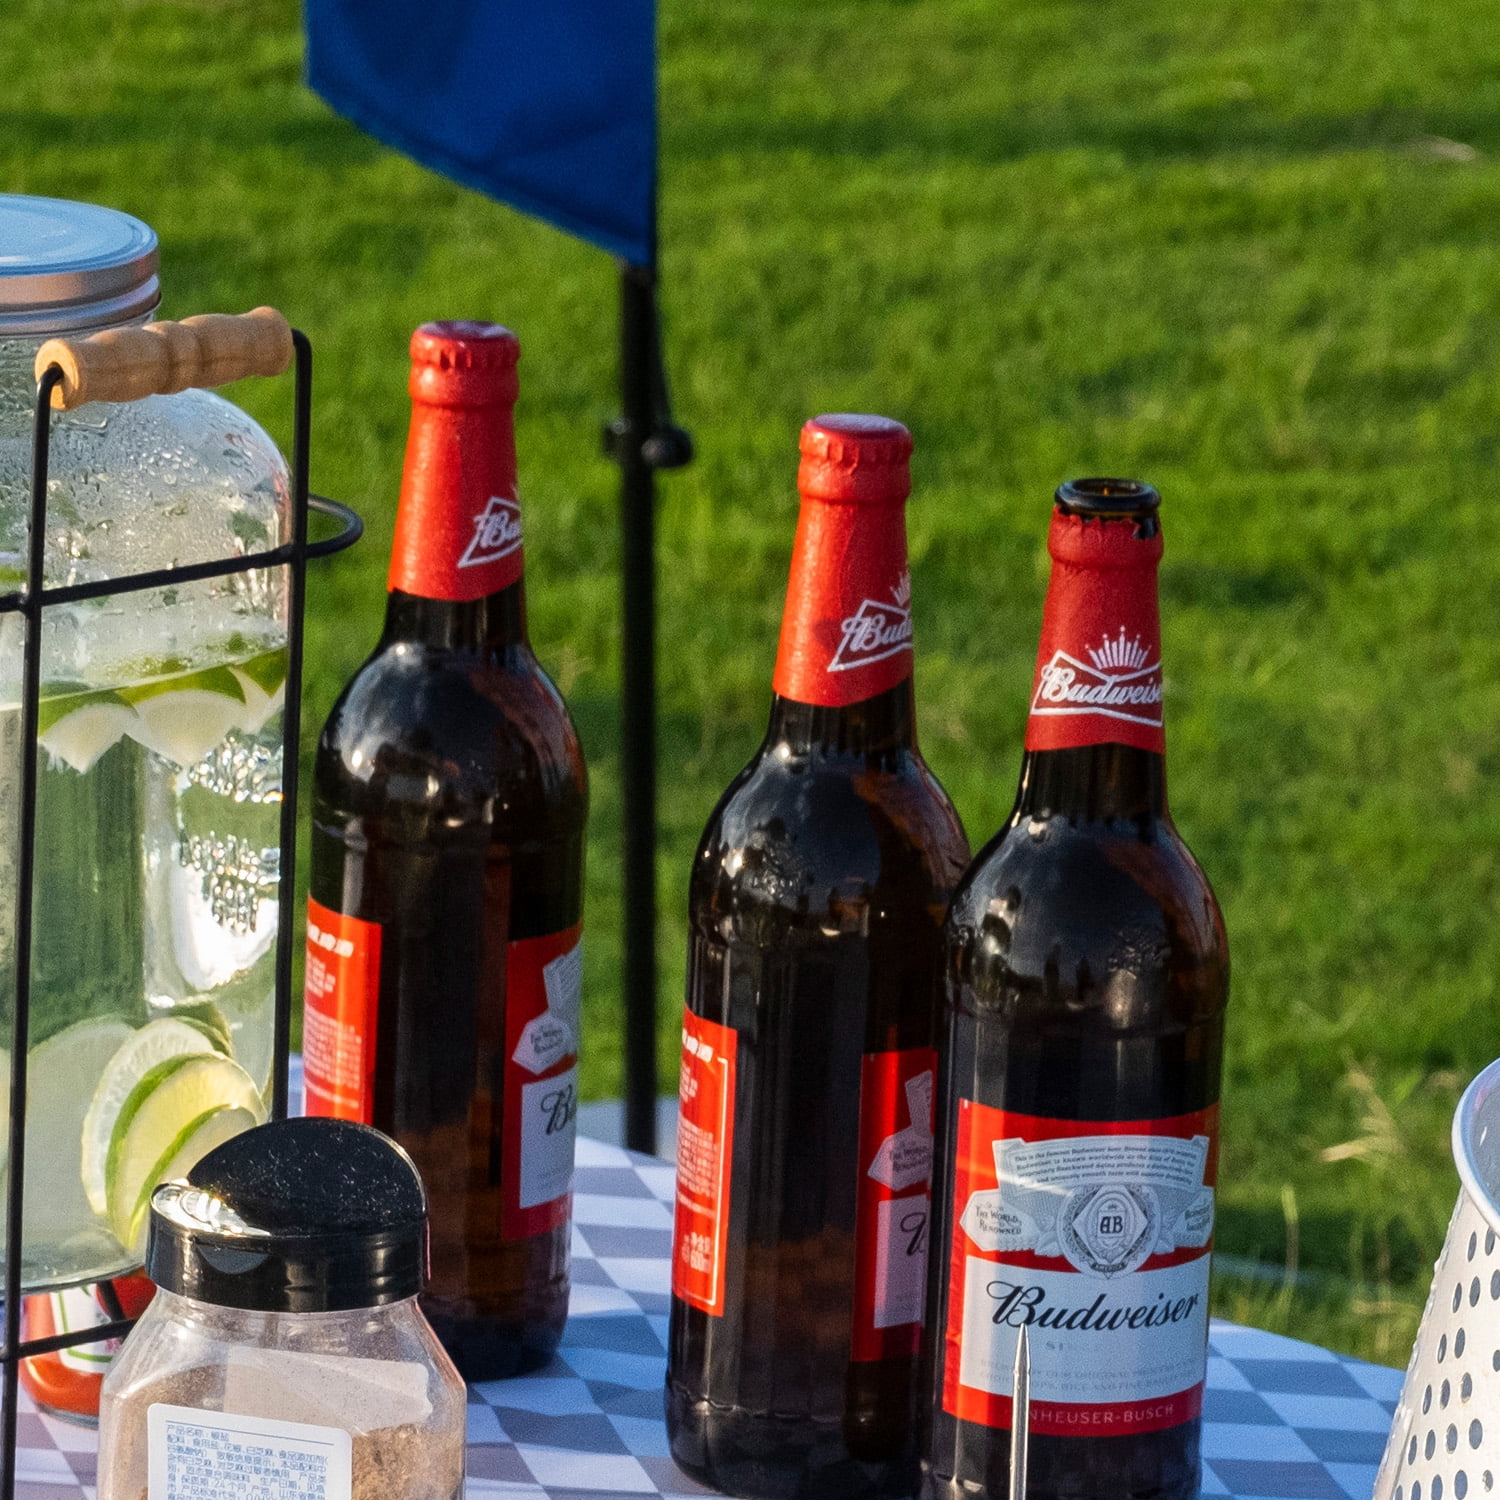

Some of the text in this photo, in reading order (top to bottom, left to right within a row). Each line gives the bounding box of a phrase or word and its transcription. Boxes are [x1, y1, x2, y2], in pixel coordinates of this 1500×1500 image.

[1099, 1215, 1124, 1235] AB
[986, 1280, 1199, 1331] Budweiser
[1030, 1406, 1174, 1424] NHEUSER-BUSCH
